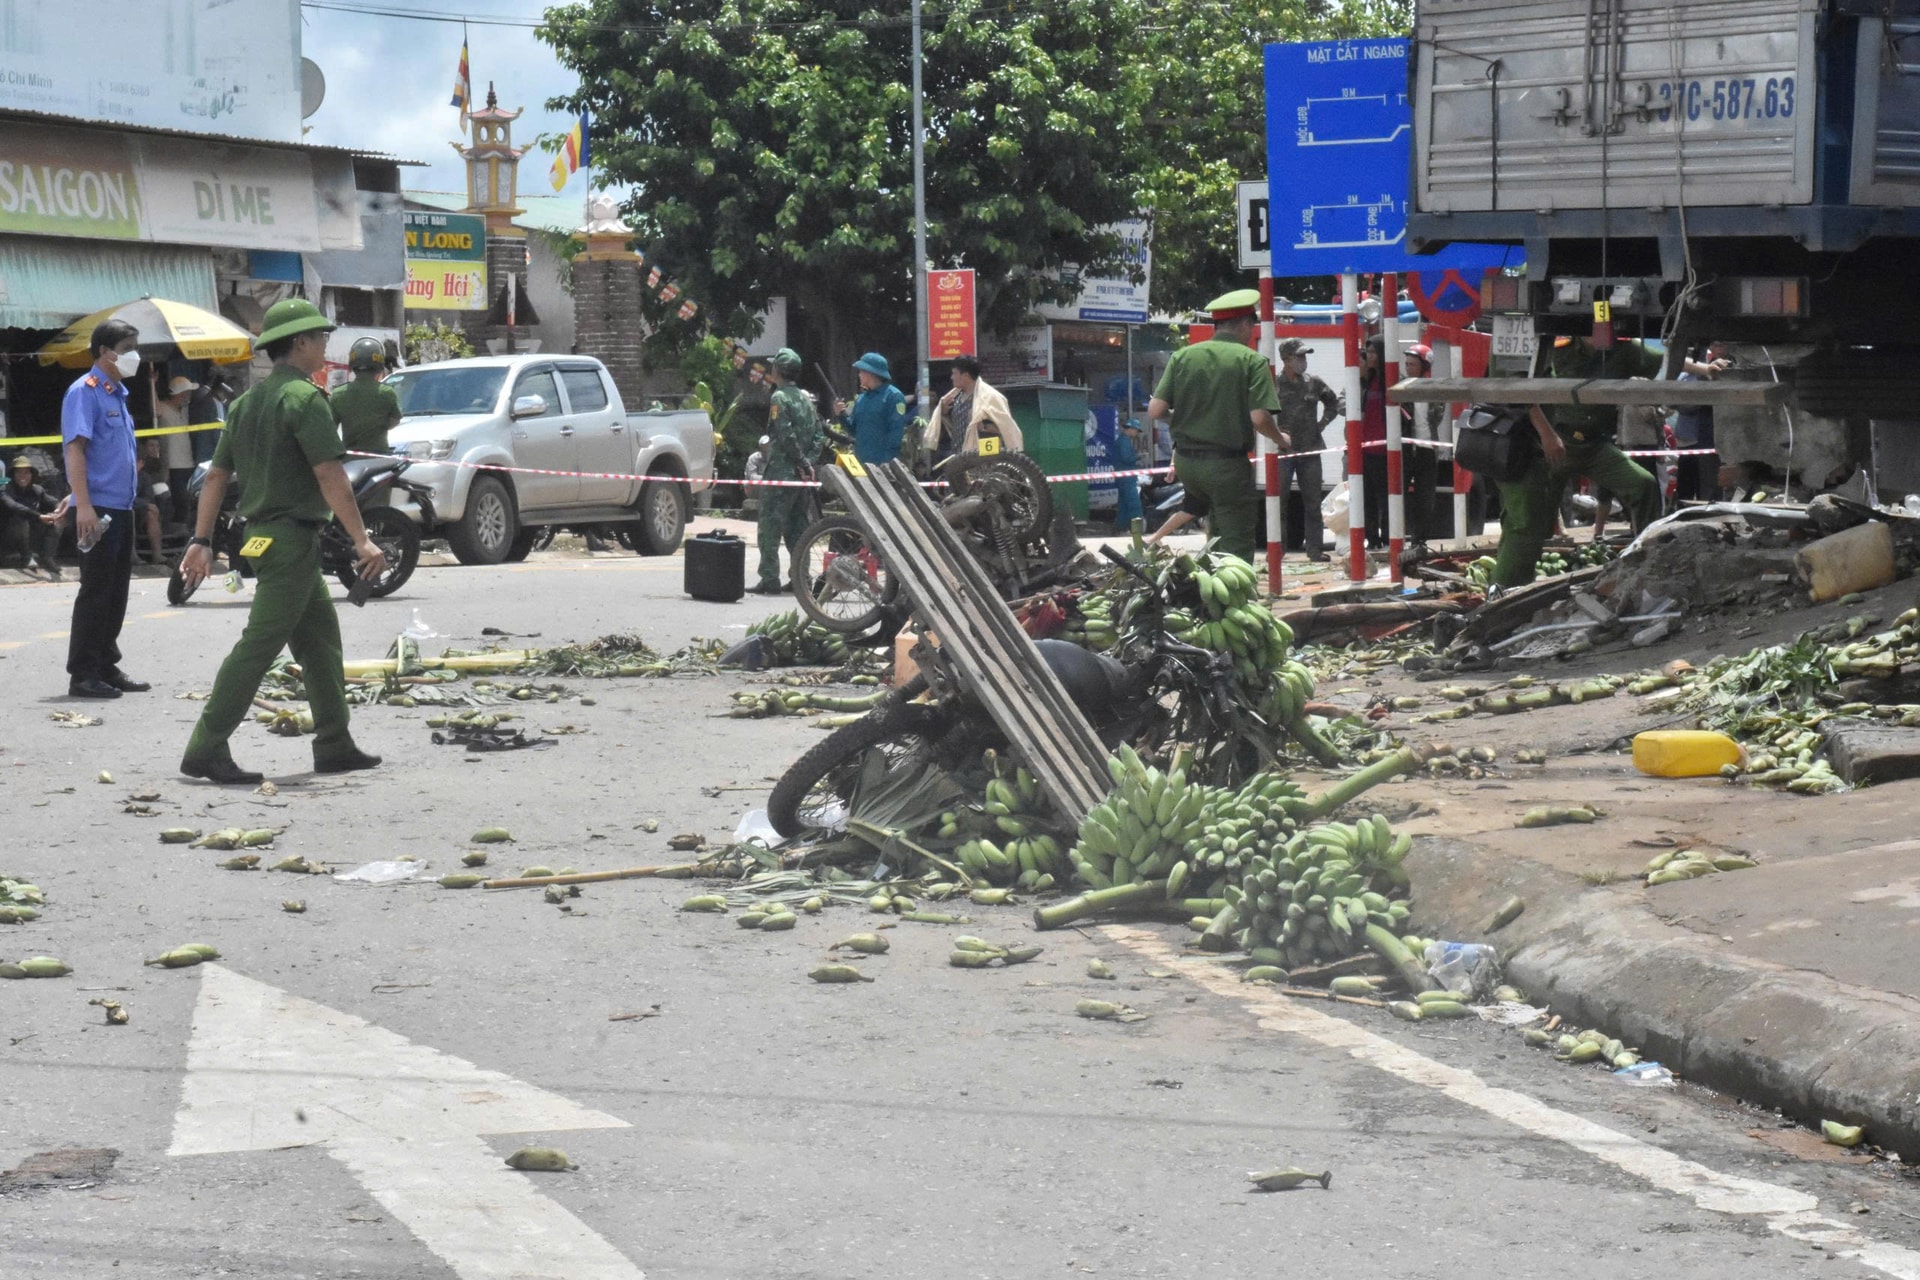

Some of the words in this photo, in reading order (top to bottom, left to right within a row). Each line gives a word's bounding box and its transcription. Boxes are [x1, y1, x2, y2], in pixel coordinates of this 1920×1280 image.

[1307, 46, 1331, 64] MẶT
[1336, 41, 1359, 61] CẮT
[1364, 44, 1405, 60] NGANG
[28, 72, 53, 89] Minh
[1658, 76, 1795, 123] 37C-587.63
[0, 160, 131, 221] SAIGON
[230, 184, 276, 225] ME
[414, 213, 429, 227] VIỆT
[431, 215, 447, 226] NAM
[422, 231, 473, 250] LONG
[443, 272, 468, 303] Hội
[1599, 304, 1606, 319] 5
[1507, 317, 1529, 335] 37C
[985, 440, 993, 452] 6
[249, 539, 266, 550] 18
